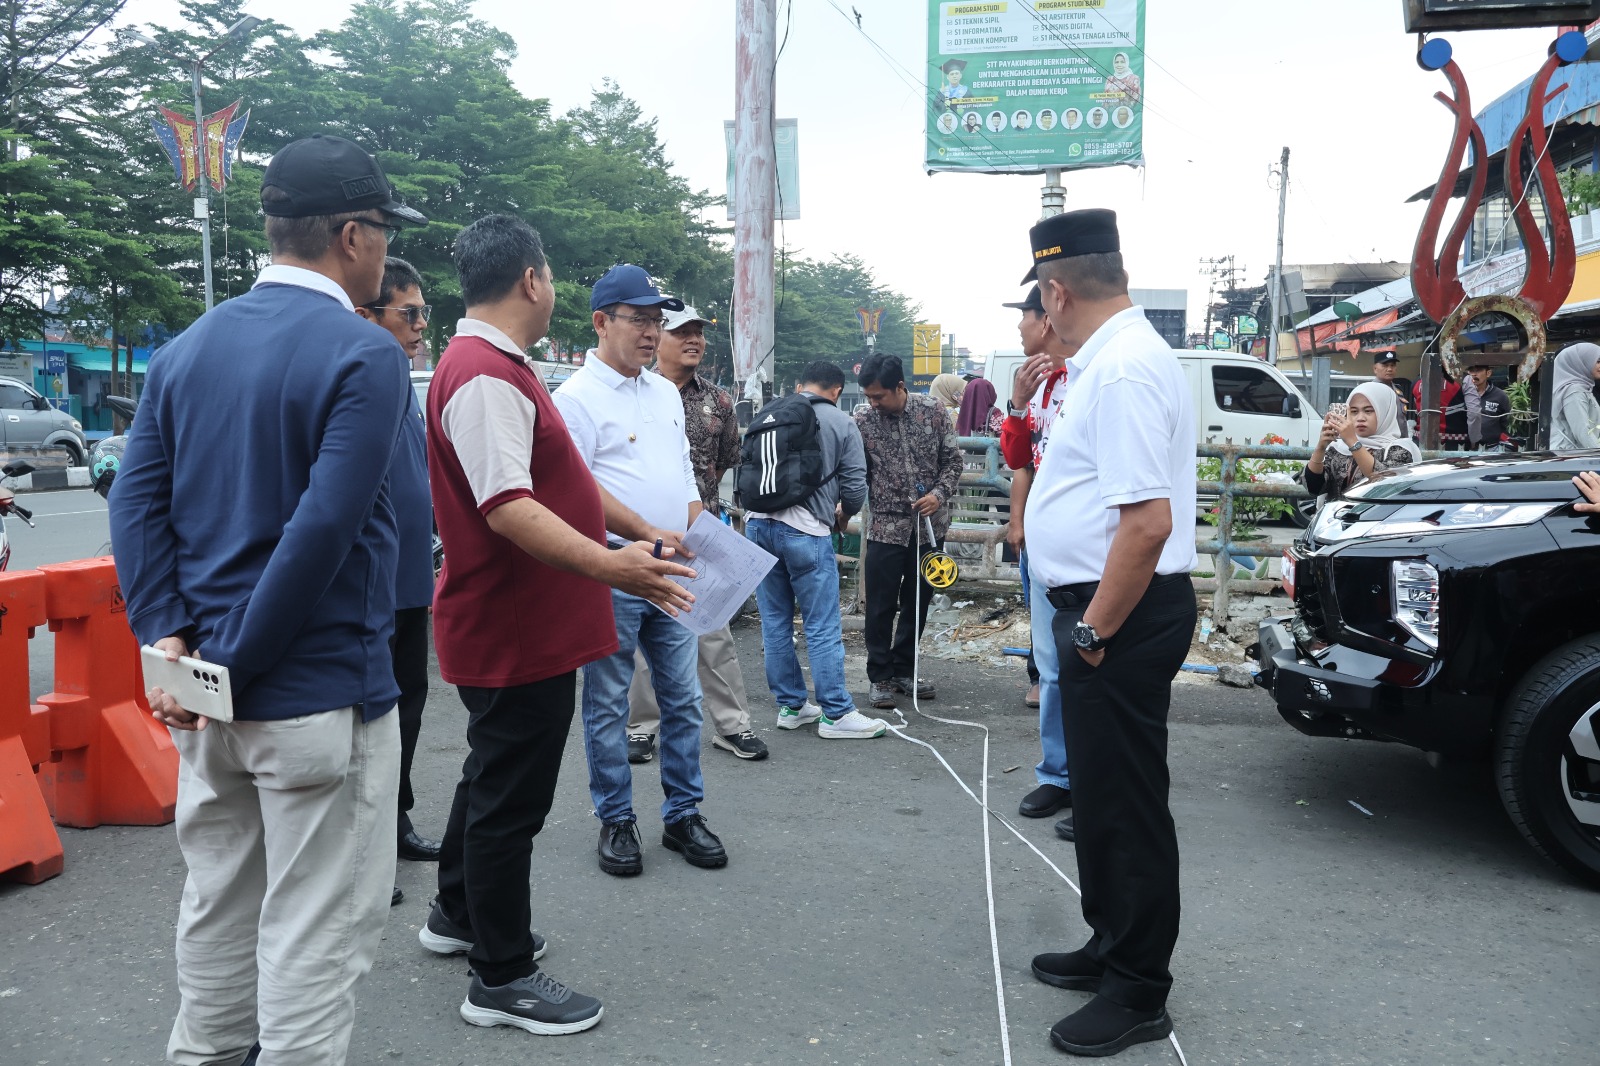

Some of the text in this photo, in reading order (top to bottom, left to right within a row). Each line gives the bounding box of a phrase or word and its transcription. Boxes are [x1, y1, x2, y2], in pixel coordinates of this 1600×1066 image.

[999, 59, 1041, 68] PAYAKUMBUH
[1044, 58, 1088, 66] BERKOMITMEN
[1001, 68, 1048, 77] MENGHASILKAN
[973, 80, 1016, 88] BERKARAKTER
